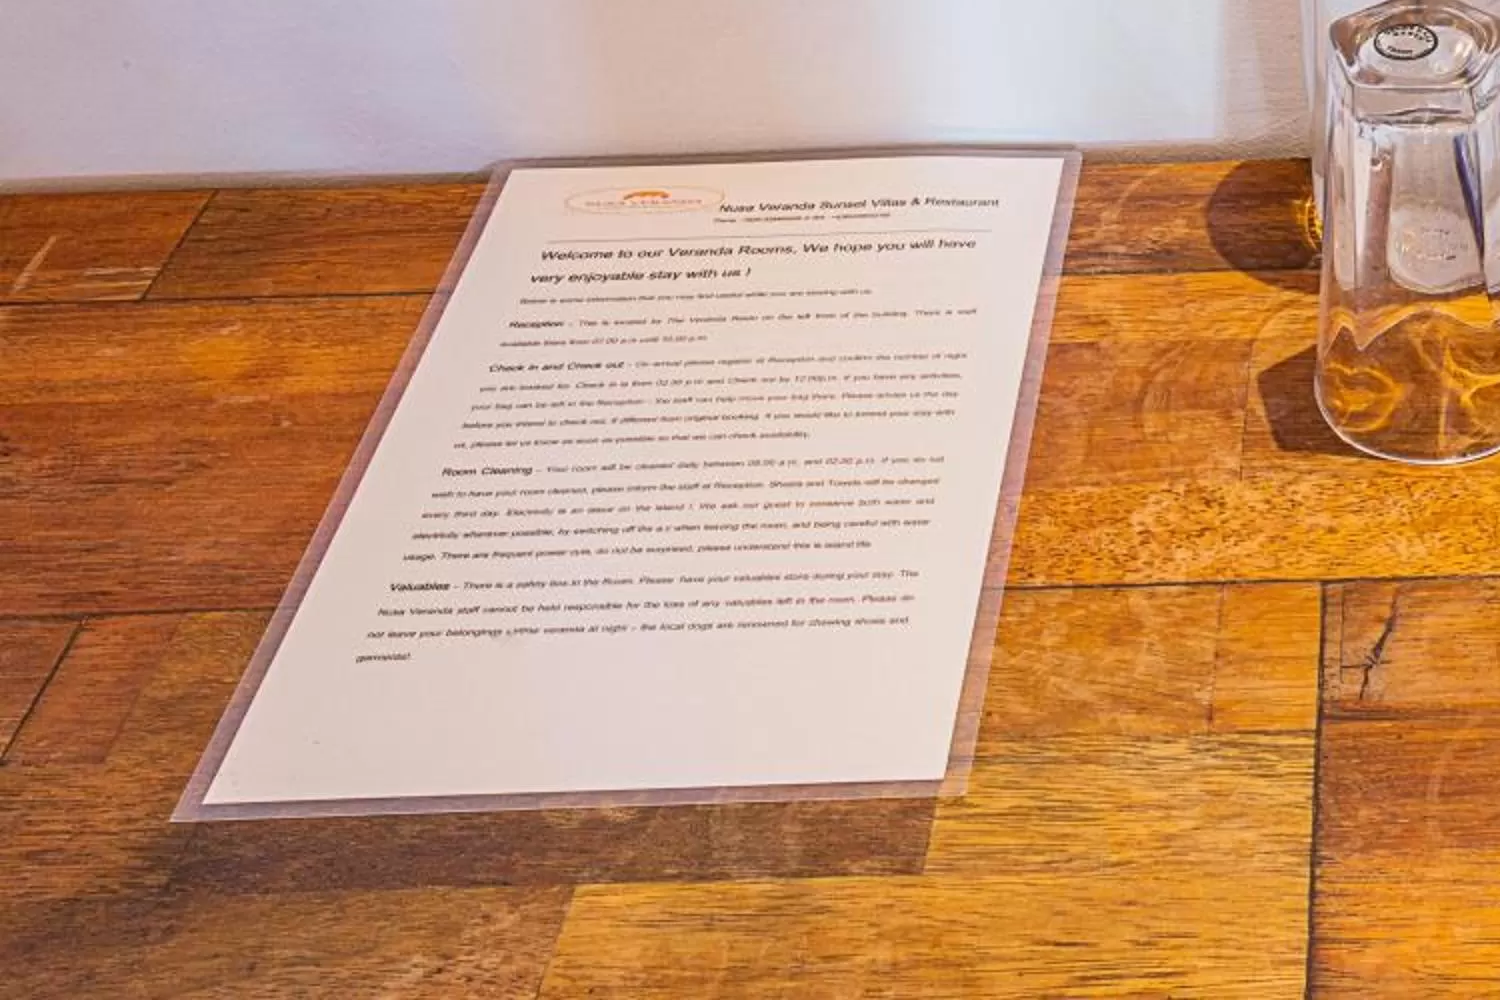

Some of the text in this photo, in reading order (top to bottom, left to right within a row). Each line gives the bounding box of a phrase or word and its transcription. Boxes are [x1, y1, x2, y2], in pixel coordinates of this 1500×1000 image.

[719, 204, 755, 213] Nusa
[759, 201, 816, 211] Veranda
[871, 198, 907, 208] Villas
[541, 249, 614, 262] Welcome
[617, 249, 633, 259] to
[637, 249, 664, 258] our
[669, 245, 733, 257] Veranda
[803, 242, 829, 253] We
[833, 241, 873, 254] hope
[876, 242, 906, 253] you
[909, 239, 935, 249] will
[938, 238, 976, 249] have
[531, 274, 565, 286] very
[568, 271, 645, 285] enjoyable
[647, 269, 682, 281] stay
[685, 268, 718, 279] with
[721, 269, 741, 278] us
[489, 363, 526, 374] Check
[541, 363, 565, 371] and
[567, 360, 603, 370] Check
[441, 466, 477, 477] Room
[480, 463, 533, 477] Cleaning
[390, 581, 451, 593] Valuables
